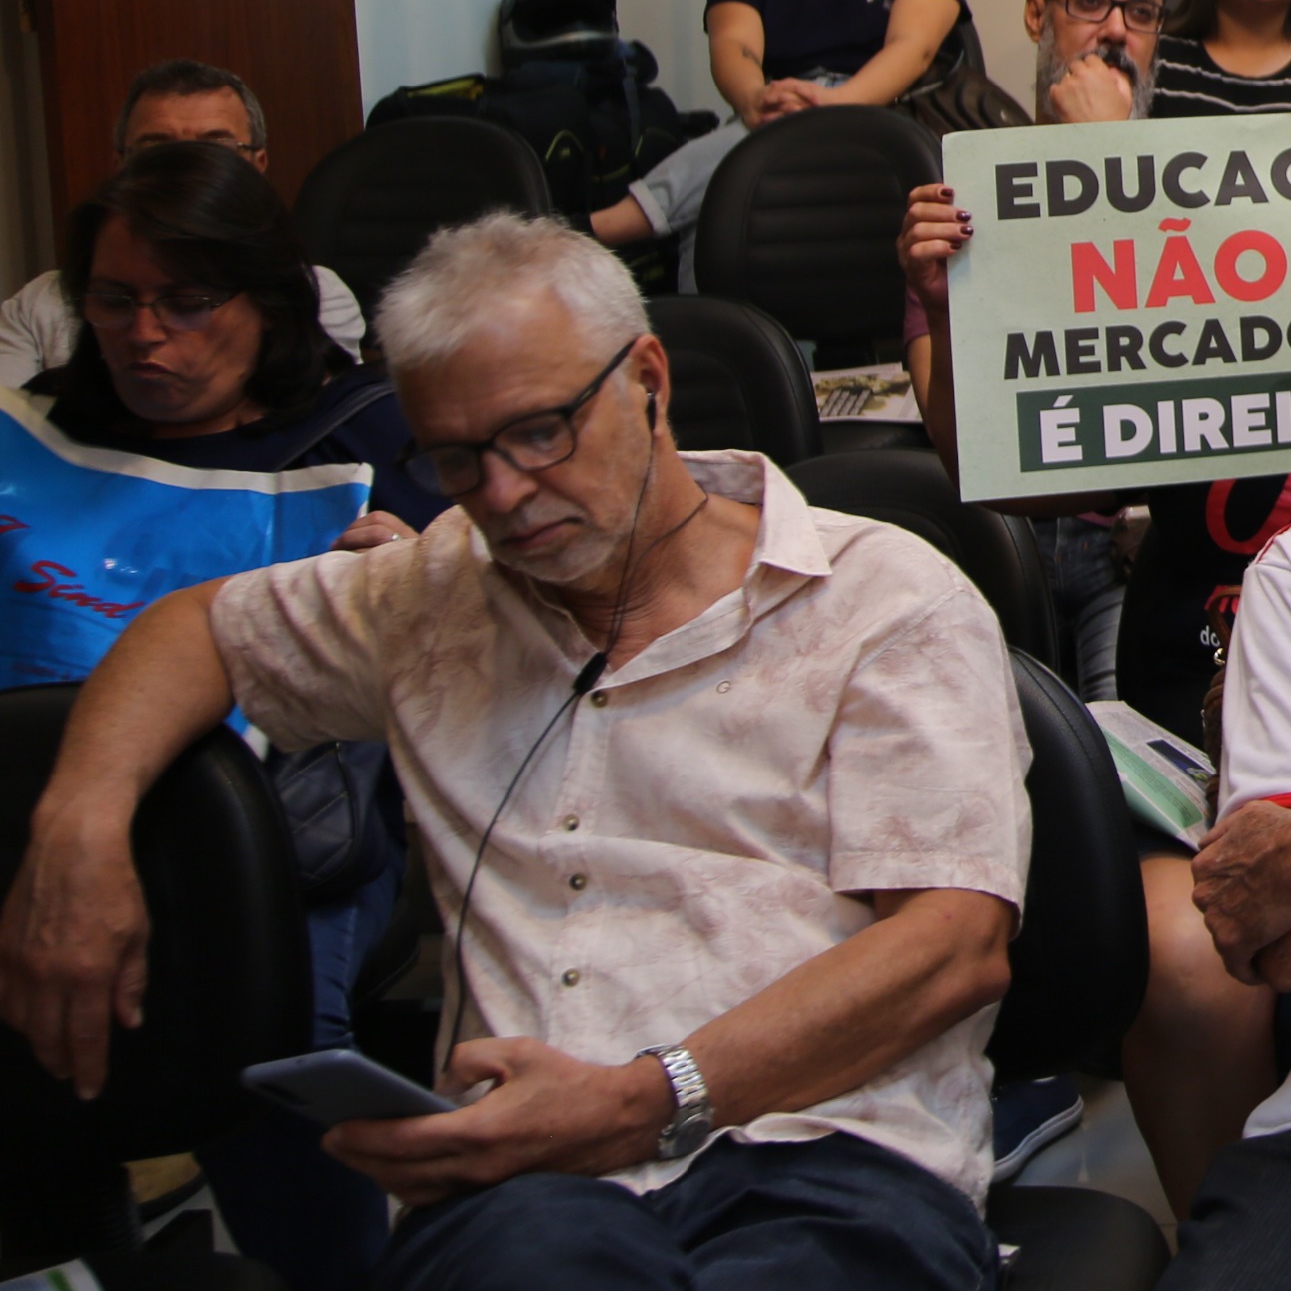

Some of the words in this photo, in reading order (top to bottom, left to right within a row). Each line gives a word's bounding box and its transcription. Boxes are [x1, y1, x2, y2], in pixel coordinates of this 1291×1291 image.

[1070, 217, 1288, 314] NÃO
[1039, 394, 1083, 464] É
[13, 559, 146, 619] Sind
